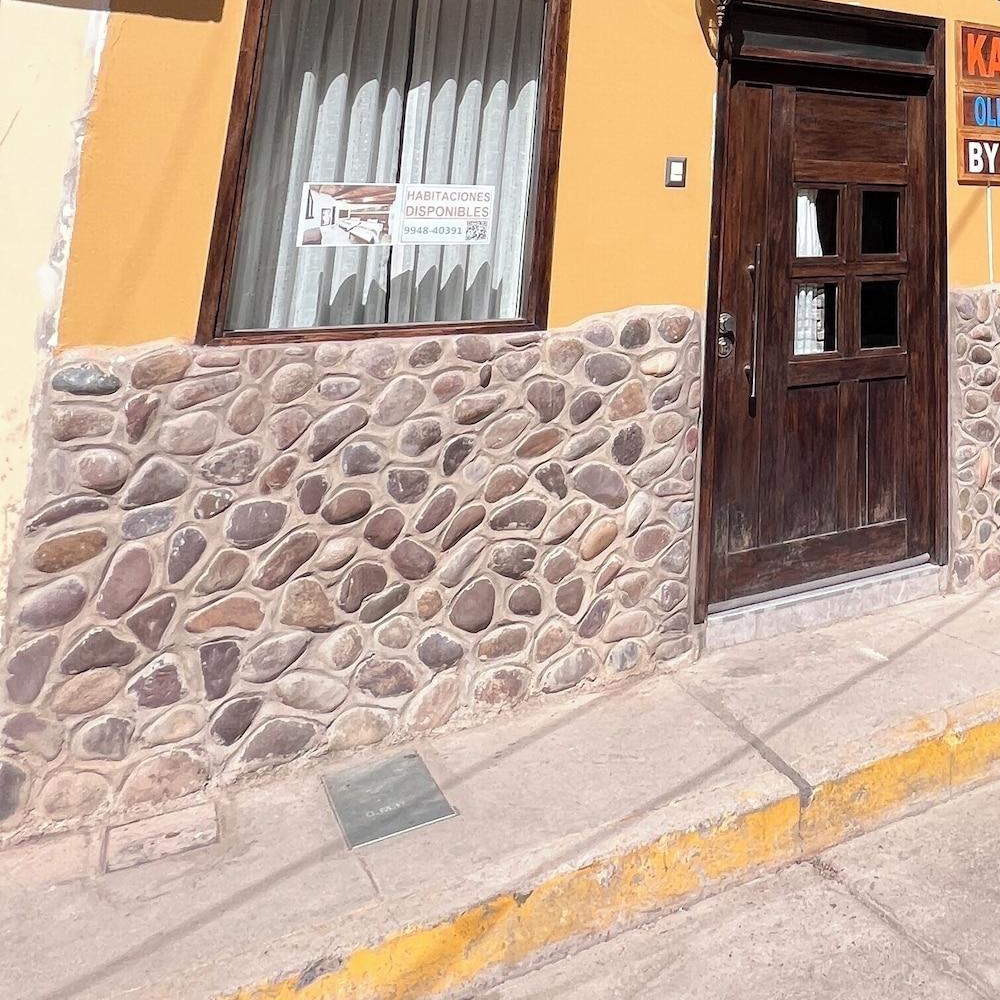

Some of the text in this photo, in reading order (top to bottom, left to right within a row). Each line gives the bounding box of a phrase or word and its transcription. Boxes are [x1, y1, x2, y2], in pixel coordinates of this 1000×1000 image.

[968, 141, 999, 174] BY
[407, 190, 491, 202] HABITACIONES
[405, 206, 489, 218] DISPONIBLES
[404, 225, 463, 236] 9948-40391
